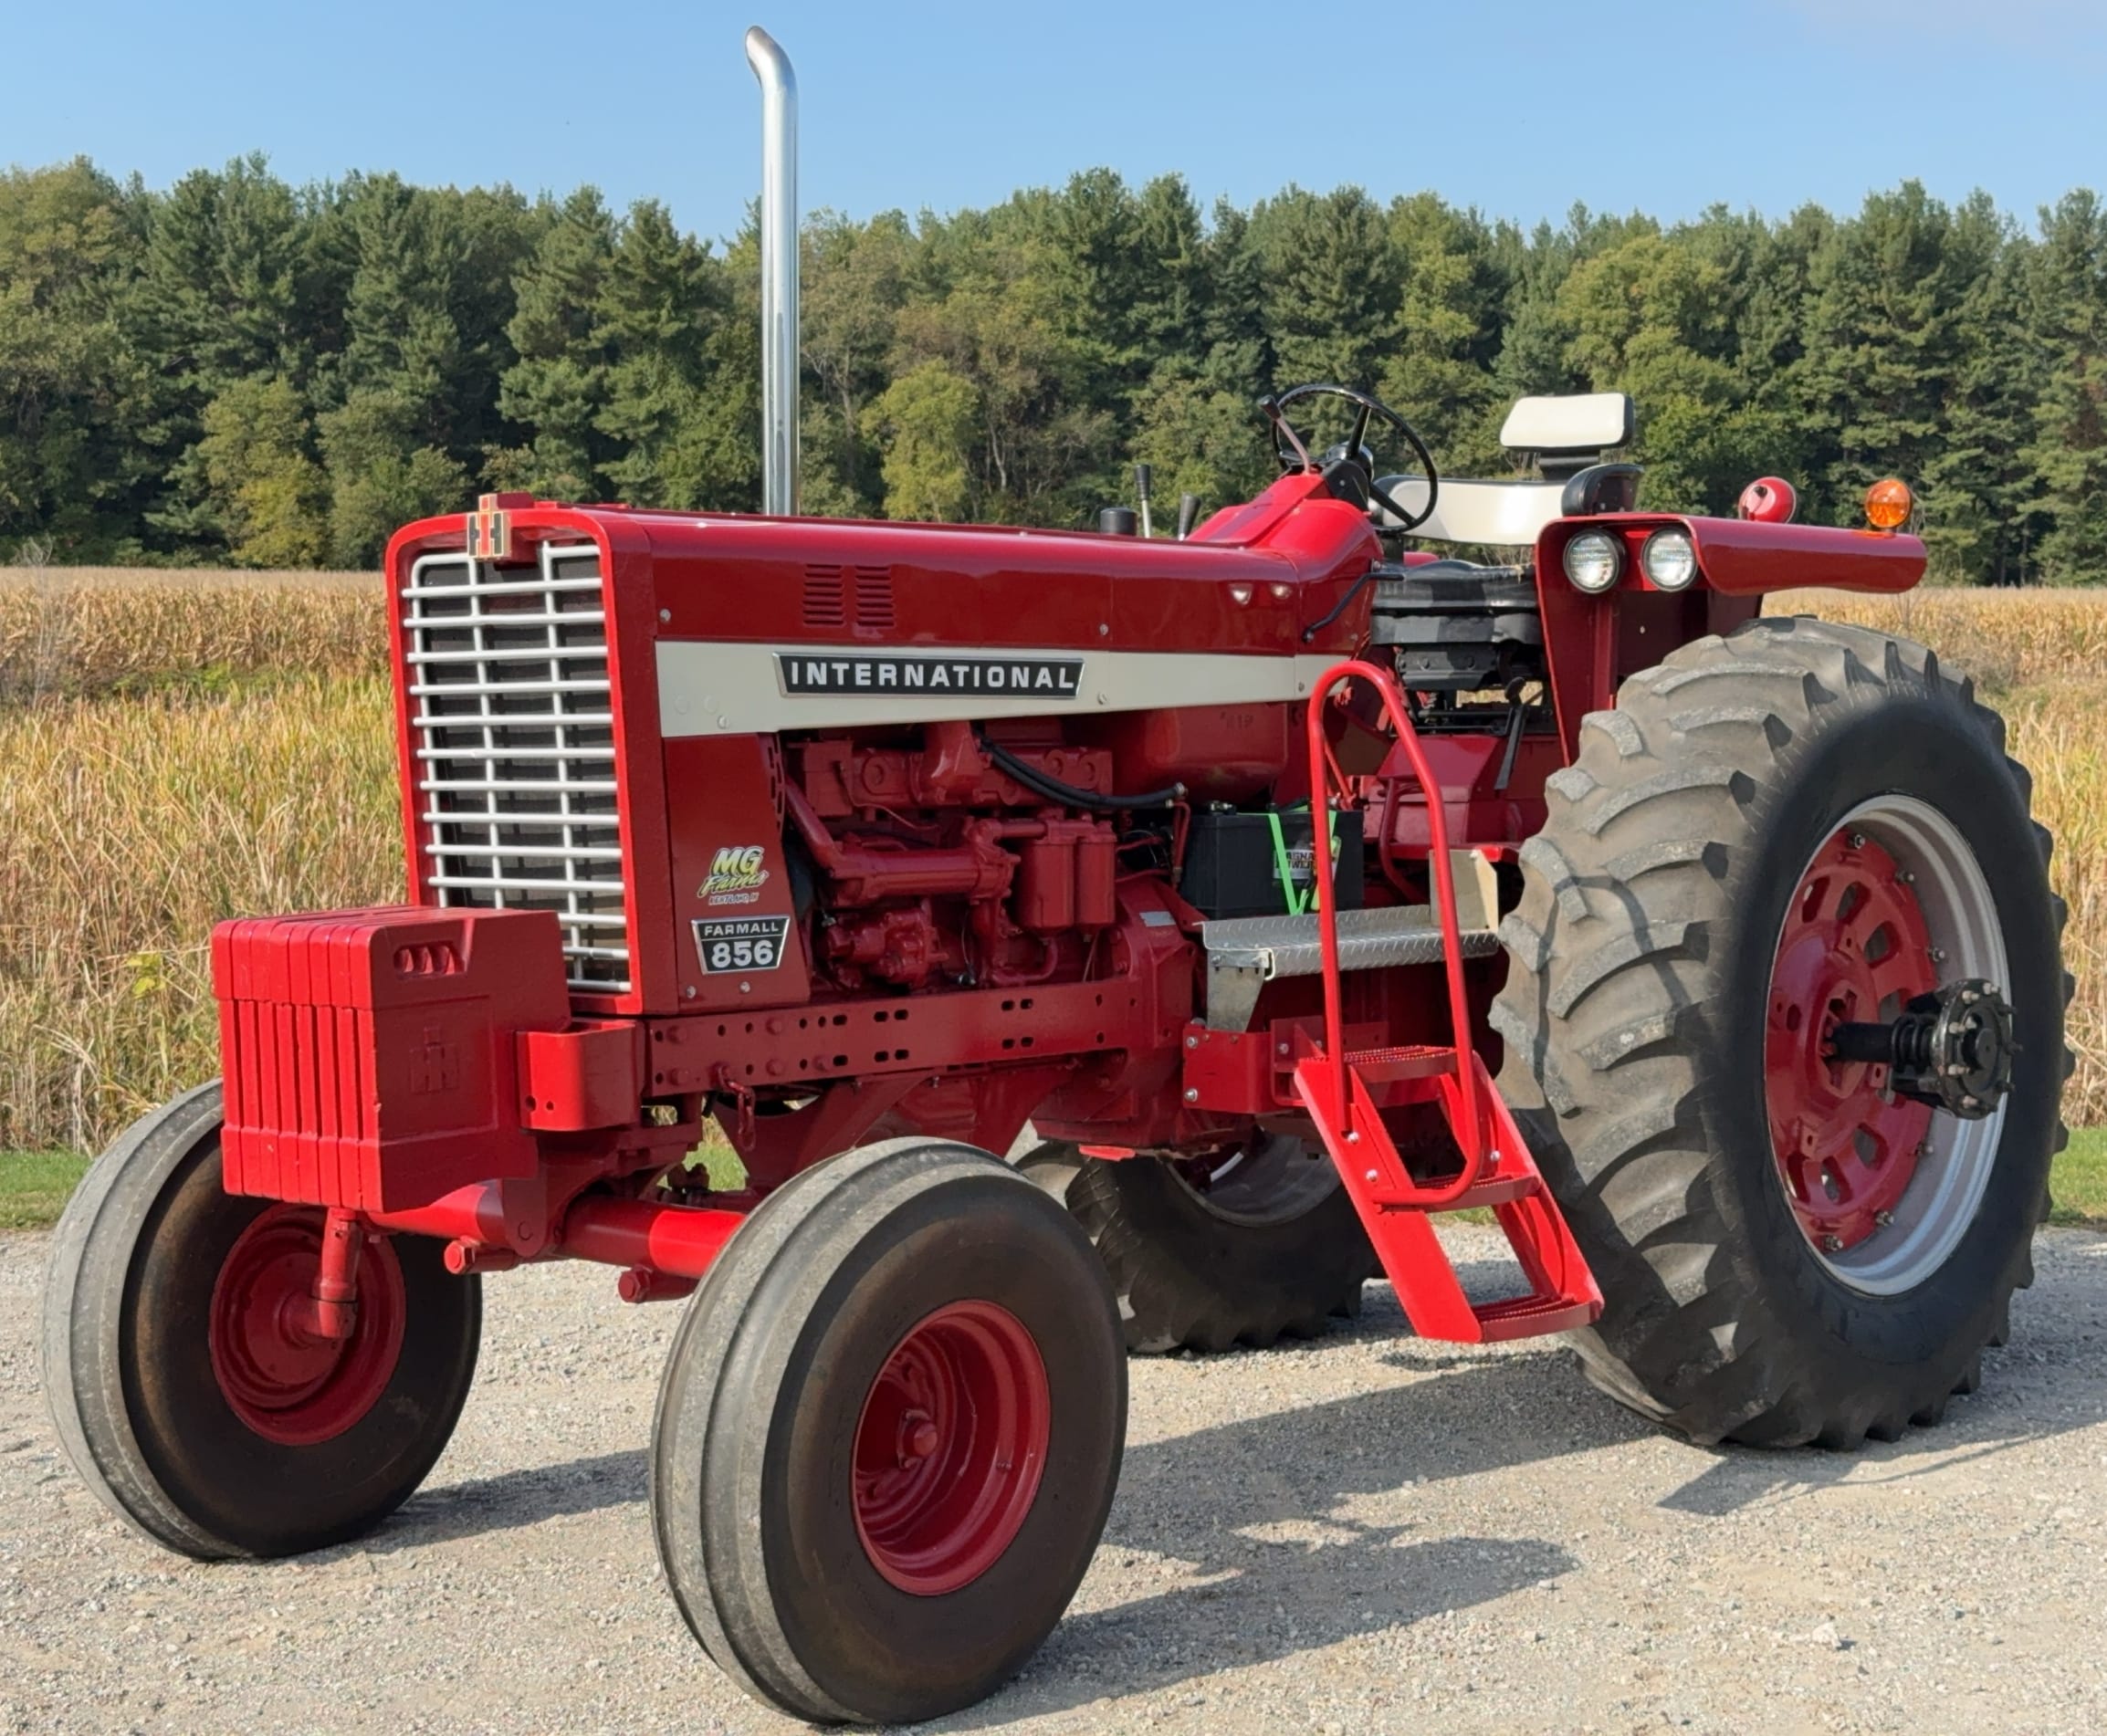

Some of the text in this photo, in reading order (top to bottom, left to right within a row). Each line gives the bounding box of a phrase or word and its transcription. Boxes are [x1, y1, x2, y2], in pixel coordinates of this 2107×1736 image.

[791, 661, 1074, 689] INTERNATIONAL
[711, 847, 764, 876] MG
[704, 922, 780, 936] FARMALL
[711, 939, 774, 968] 856
